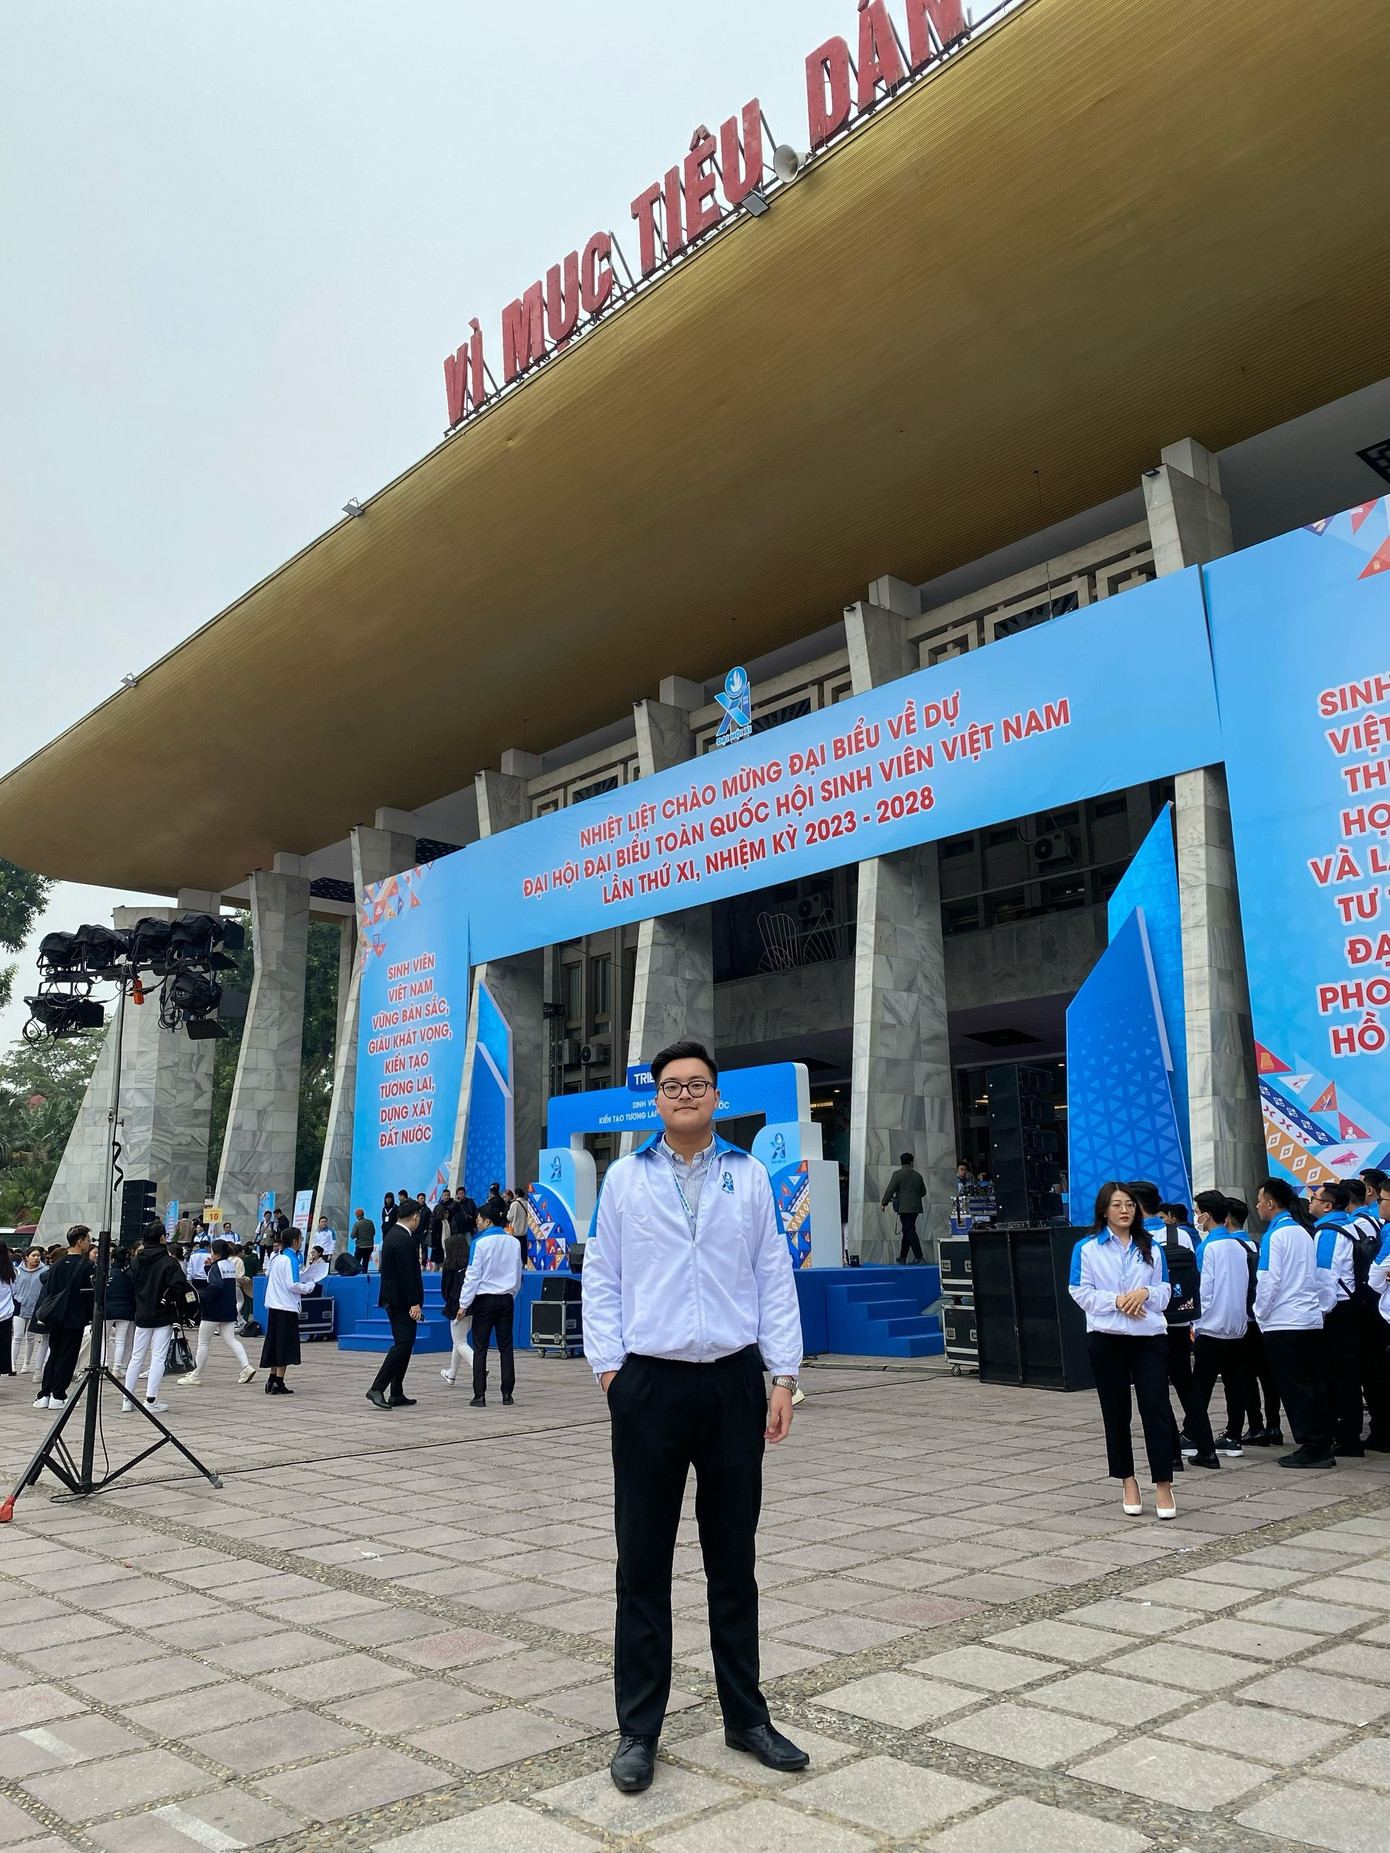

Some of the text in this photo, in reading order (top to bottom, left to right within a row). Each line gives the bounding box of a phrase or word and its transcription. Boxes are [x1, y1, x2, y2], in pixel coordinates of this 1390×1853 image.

[443, 317, 485, 426] VÌ
[502, 231, 614, 384] MỤC
[631, 97, 763, 278] TIÊU
[580, 691, 960, 848] NHIỆT LIỆT CHÀO MỪNG ĐẠI BIỂU VỀ DỰ
[1344, 759, 1390, 793] TH
[523, 699, 1070, 898] ĐẠI HỘI ĐẠI BIỂU TOÀN QUỐC HỘI SINH VIÊN VIỆT NAM
[1342, 803, 1390, 837] HỌ
[603, 873, 634, 904] LẦN
[638, 862, 671, 893] THỨ
[676, 859, 701, 883] XI,
[706, 838, 766, 875] NHIỆM
[772, 823, 798, 855] KỲ
[805, 810, 857, 845] 2023
[877, 786, 934, 824] 2028
[1311, 847, 1360, 884] VÀ
[1337, 887, 1379, 922] TƯ
[388, 953, 435, 980] SINH VIÊN
[1348, 934, 1390, 967] ĐẠ
[388, 979, 433, 1004] VIỆT NAM
[1320, 979, 1390, 1012] PHO
[372, 994, 449, 1030] VỮNG BẢN SẮC,
[368, 1023, 452, 1054] GIÀU KHÁT VỌNG,
[1332, 1011, 1386, 1055] HỒ
[384, 1052, 429, 1074] KIẾN TẠO
[380, 1076, 435, 1099] TƯƠNG LAI,
[380, 1098, 433, 1126] DỰNG XÂY
[632, 1101, 647, 1109] SINH
[379, 1123, 432, 1147] ĐẤT NƯỚC
[209, 1212, 219, 1221] 10
